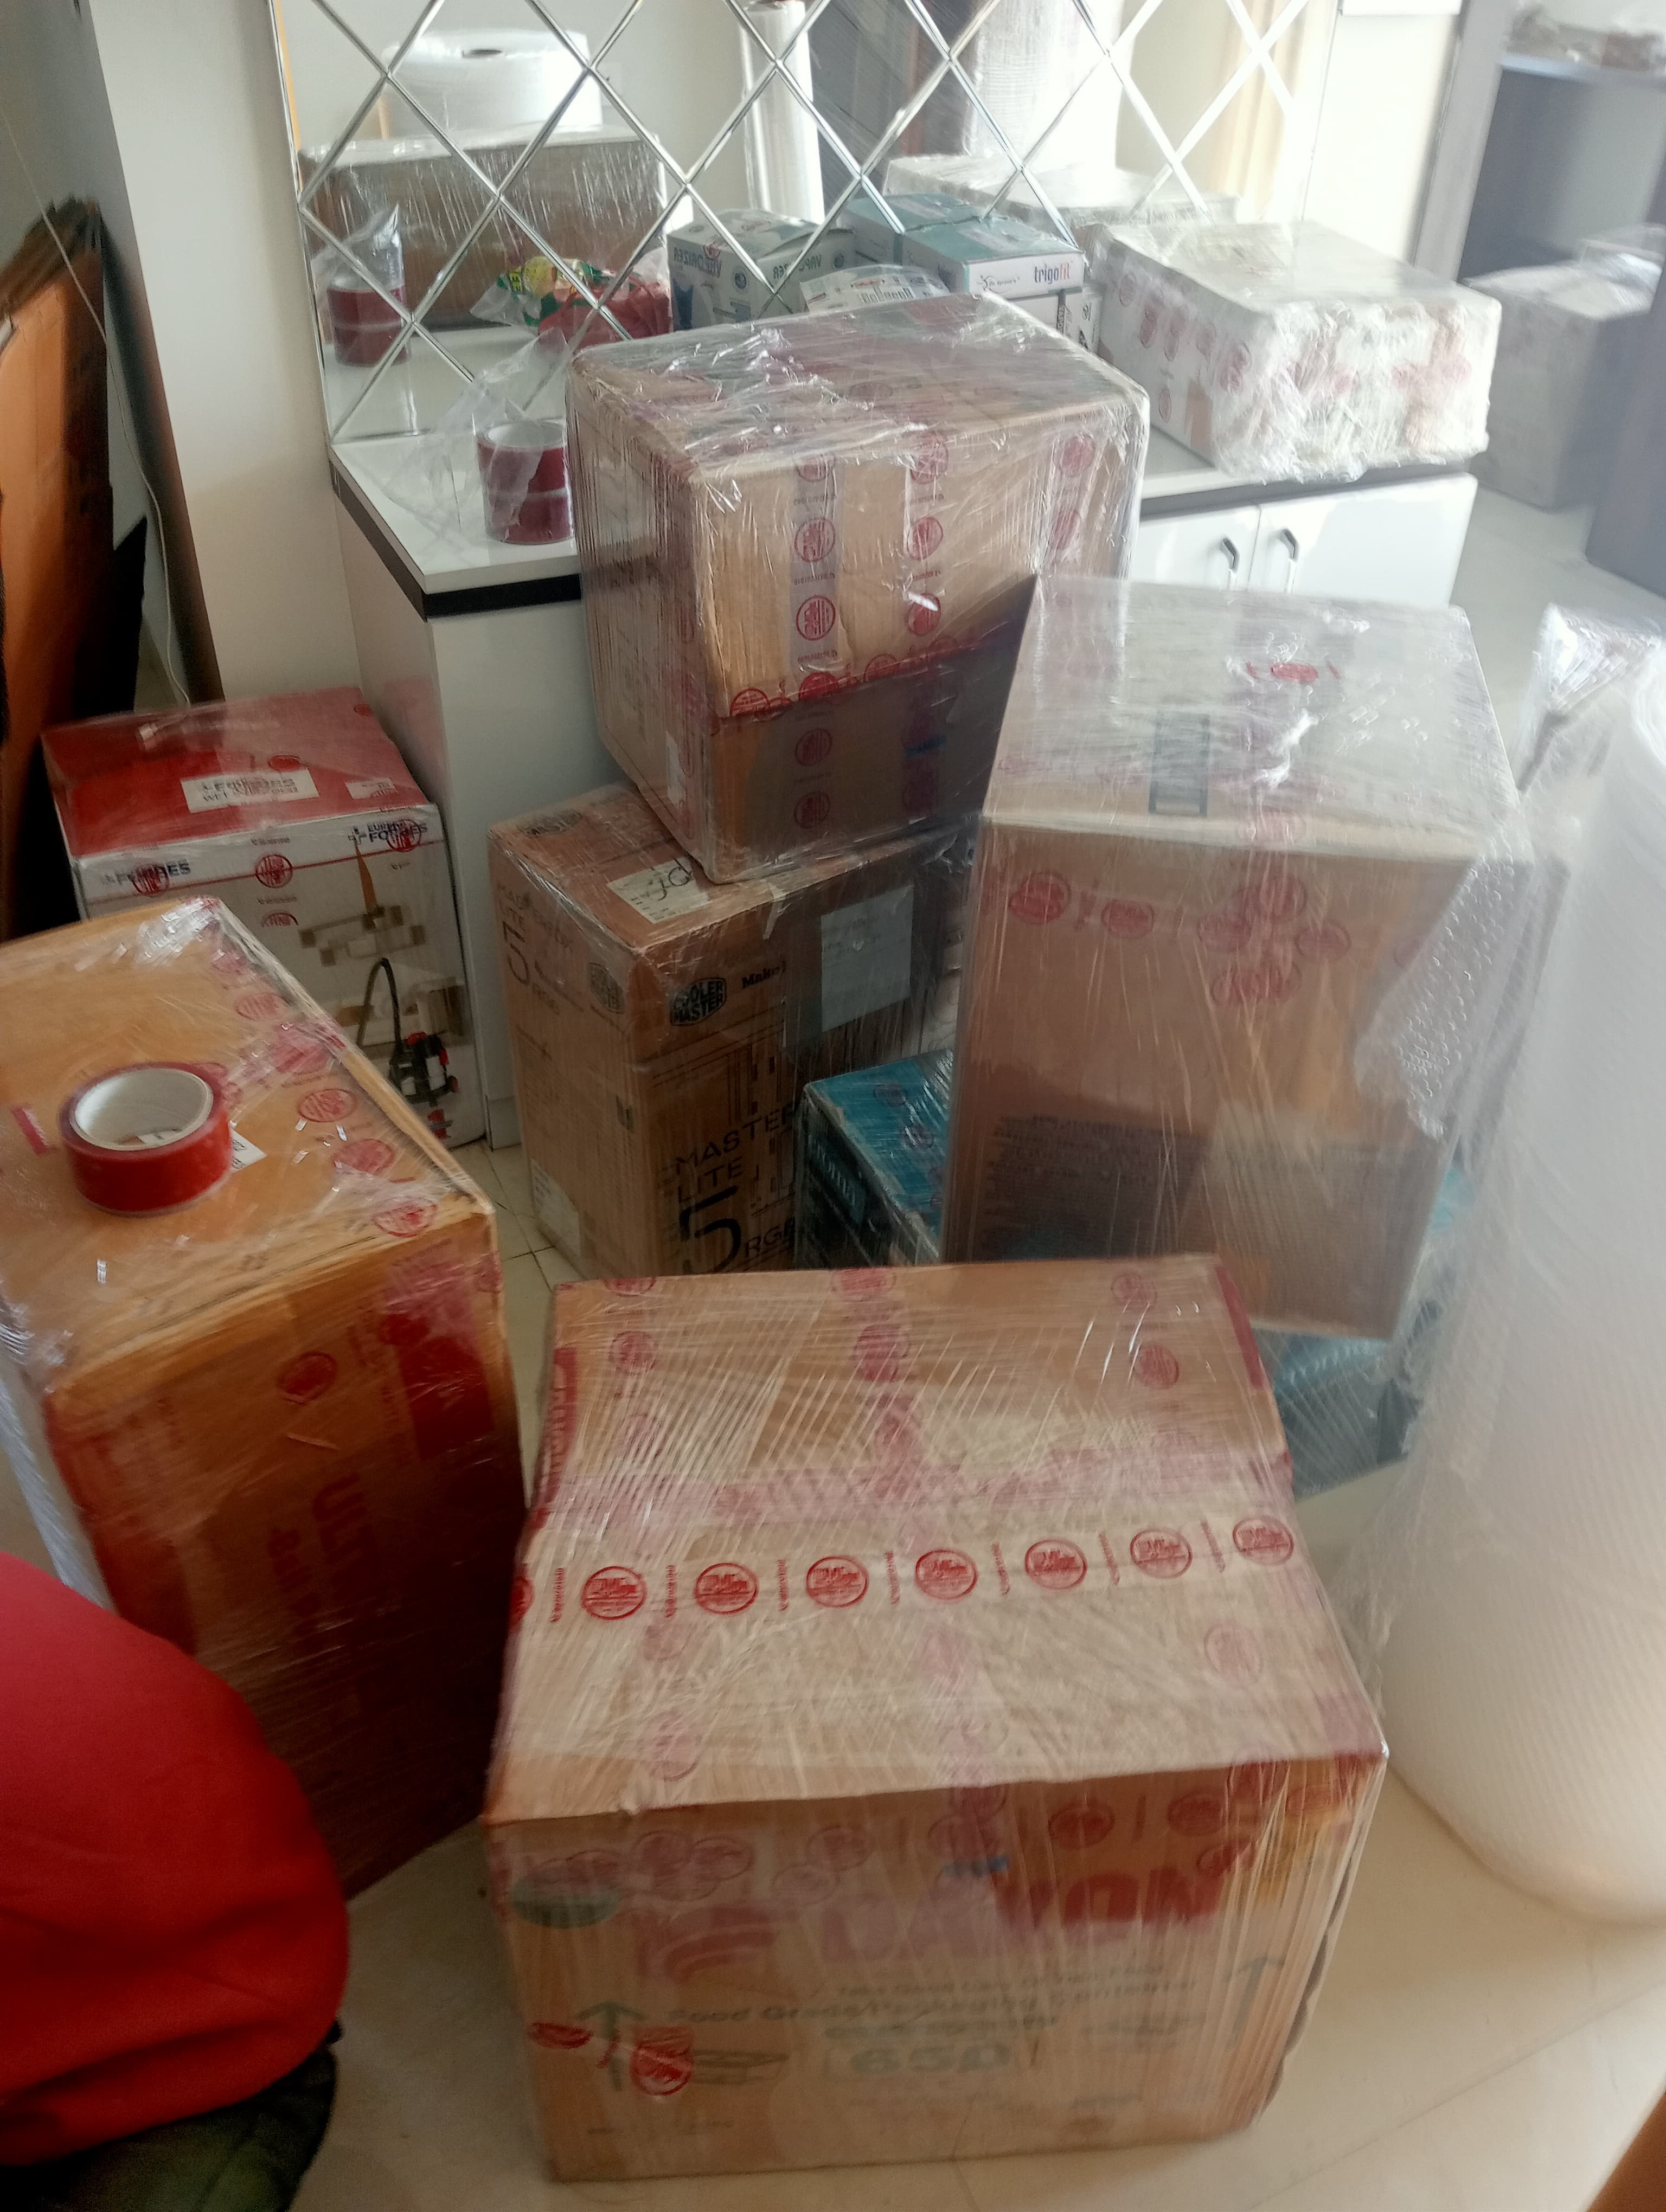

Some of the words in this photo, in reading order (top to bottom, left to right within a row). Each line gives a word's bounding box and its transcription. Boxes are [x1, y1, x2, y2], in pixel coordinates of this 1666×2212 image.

[1035, 262, 1071, 285] trigofit
[678, 1155, 744, 1204] LITE
[678, 1185, 742, 1272] 5
